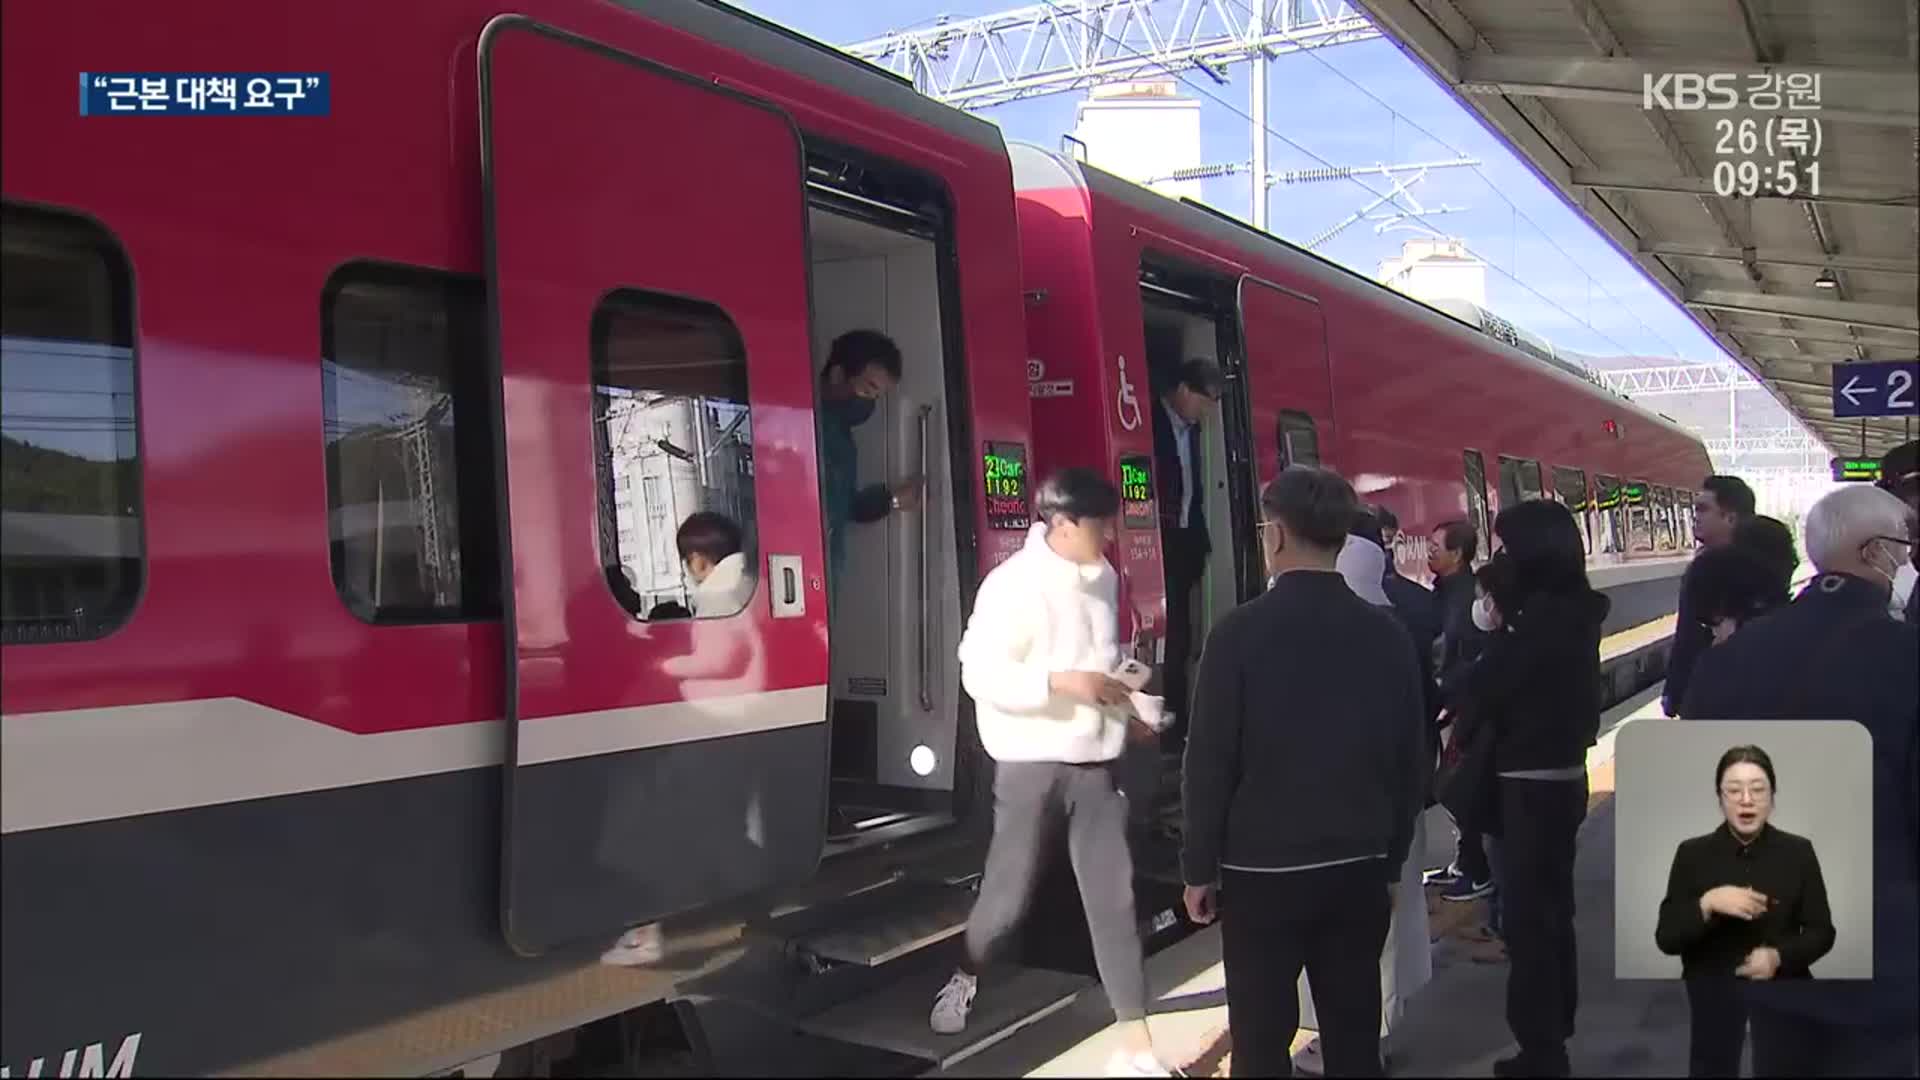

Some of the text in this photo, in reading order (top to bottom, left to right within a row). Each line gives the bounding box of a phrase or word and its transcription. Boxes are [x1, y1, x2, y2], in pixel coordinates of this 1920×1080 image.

[1887, 369, 1915, 408] 2
[986, 479, 1019, 496] 1192
[1123, 484, 1147, 500] 1192
